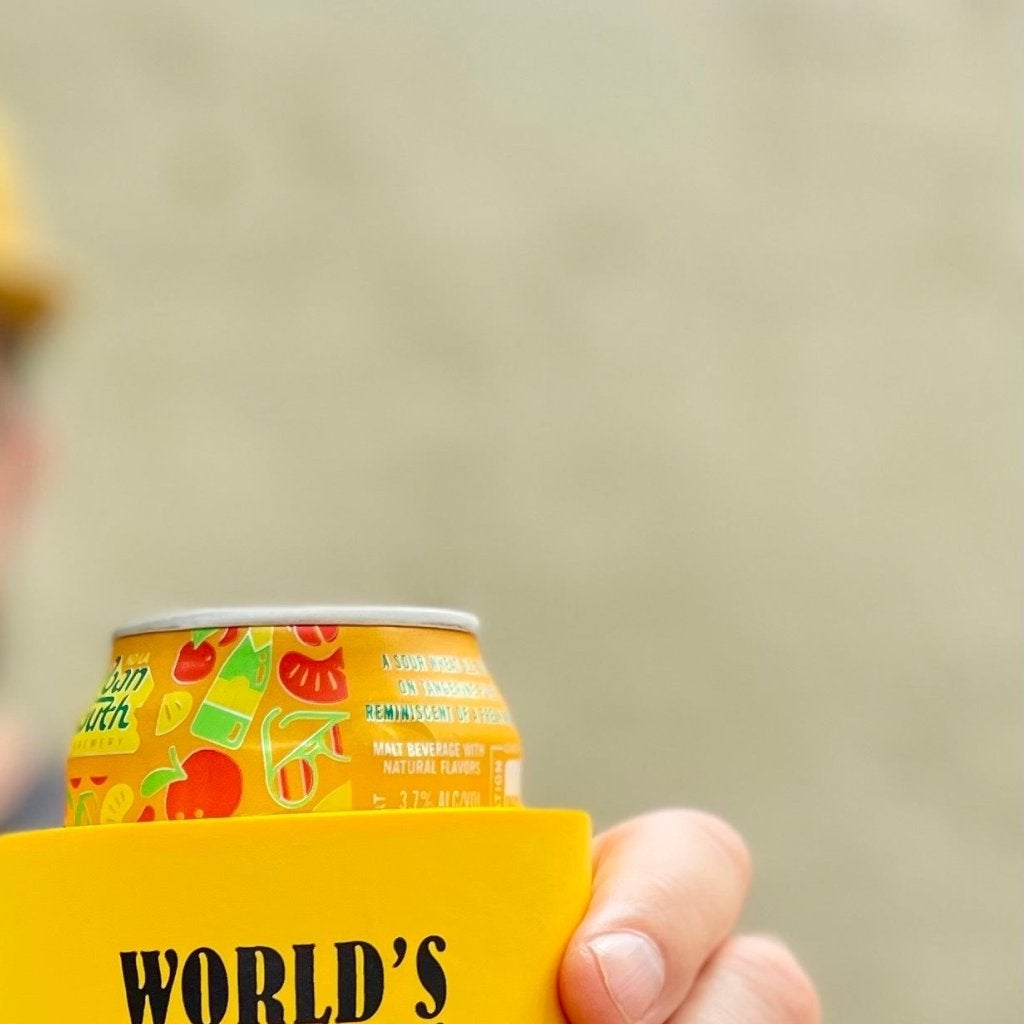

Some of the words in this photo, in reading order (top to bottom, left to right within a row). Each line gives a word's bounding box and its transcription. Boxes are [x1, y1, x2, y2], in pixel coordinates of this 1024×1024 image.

[382, 653, 391, 669] A
[393, 654, 427, 671] SOUR
[101, 655, 148, 694] ban
[398, 679, 417, 696] ON
[80, 694, 130, 732] uth
[365, 703, 451, 723] REMINISCENT
[373, 741, 403, 757] MALT
[407, 741, 461, 758] BEVERAGE
[463, 743, 486, 757] WITH
[383, 759, 437, 775] NATURAL
[440, 760, 480, 775] FLAVORS
[399, 789, 433, 809] 37%
